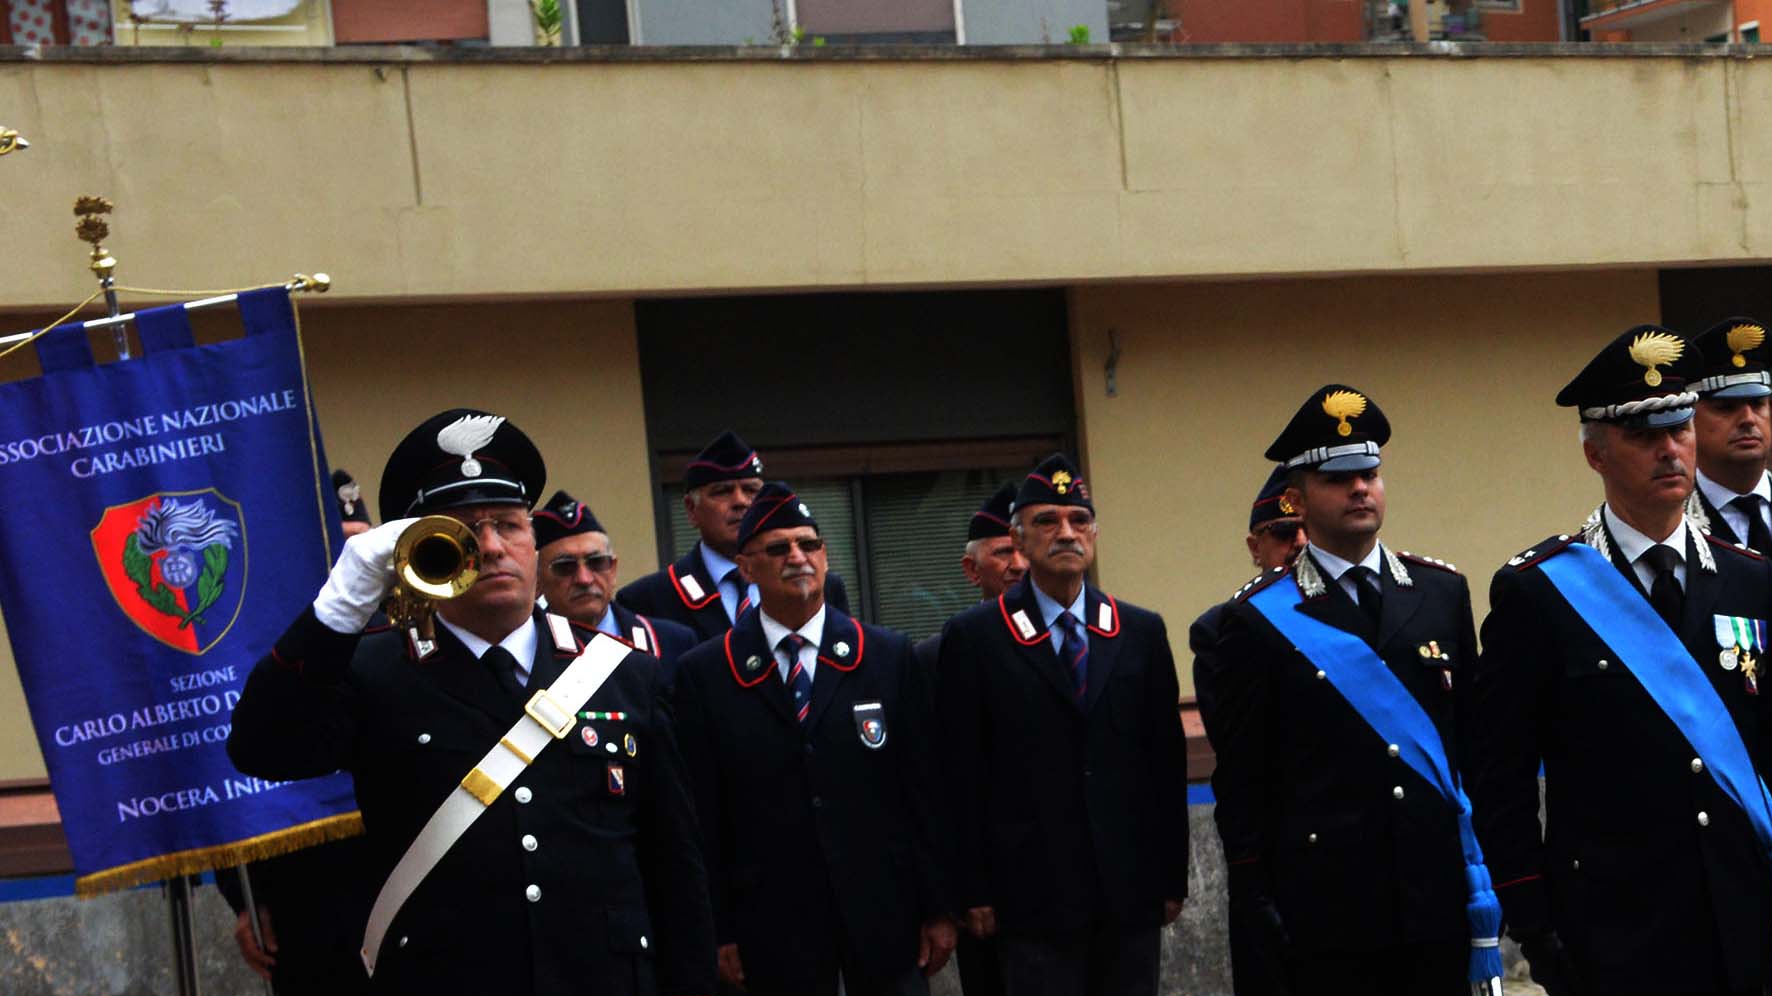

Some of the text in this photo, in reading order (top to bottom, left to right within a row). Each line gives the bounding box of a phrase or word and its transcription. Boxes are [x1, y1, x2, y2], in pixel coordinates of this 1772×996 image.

[0, 389, 297, 465] SSOCIAZIONE NAZIONALE
[71, 432, 225, 479] CARABINIERI
[170, 665, 238, 693] SEZIONE
[55, 689, 241, 747] CARLO ALBERTO D
[98, 723, 233, 766] GENERALE DI CO
[116, 784, 220, 823] NOCERA
